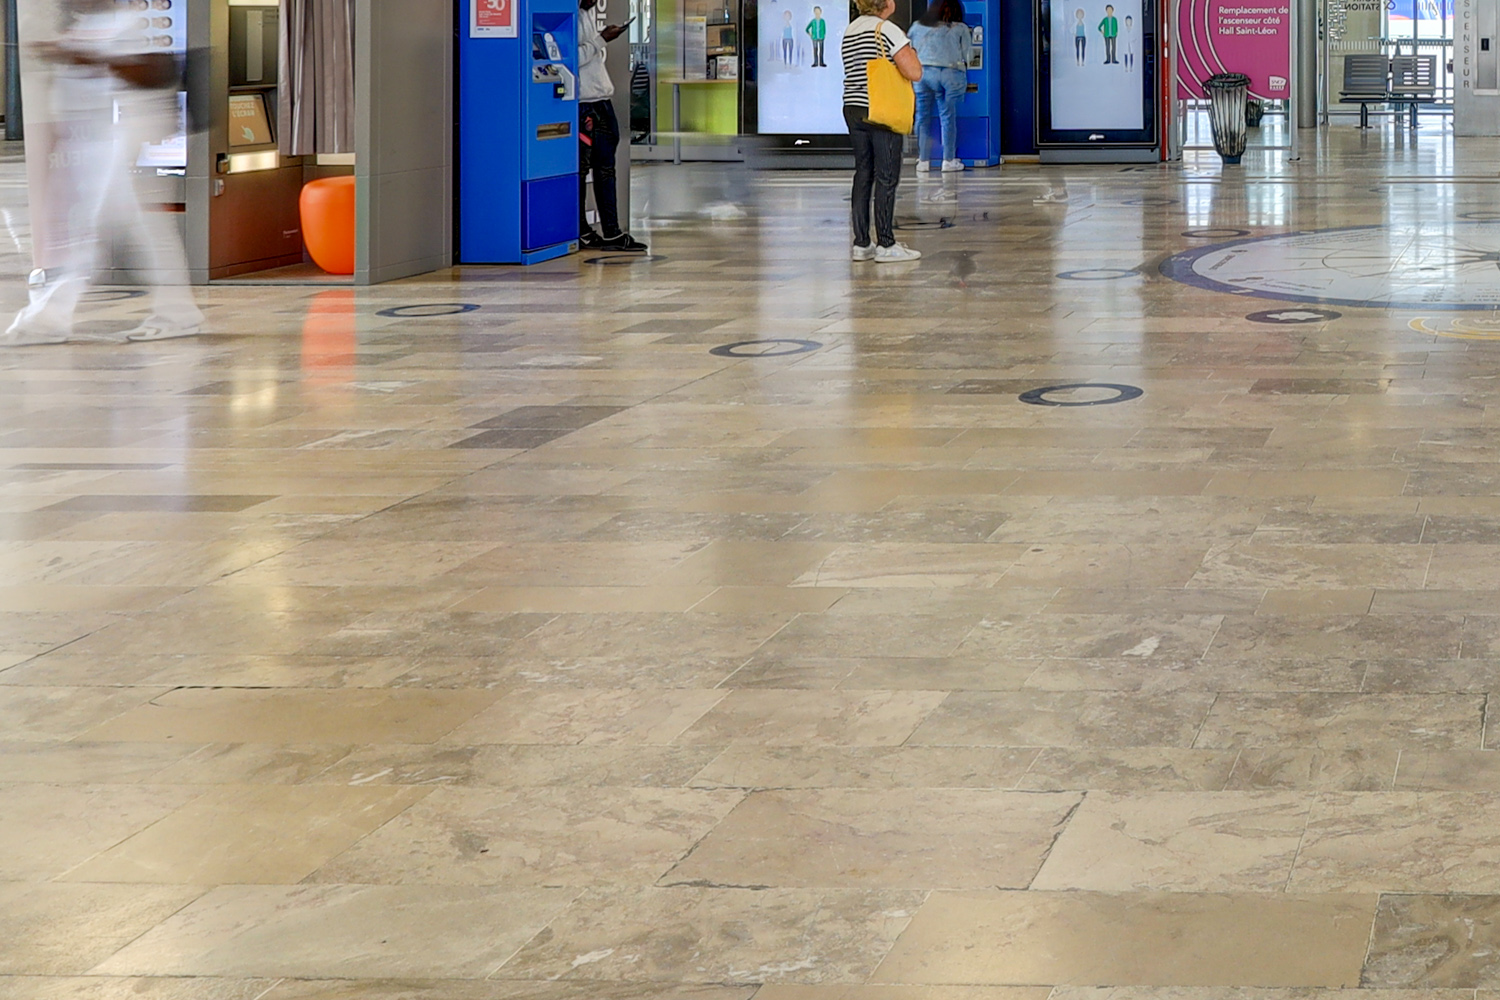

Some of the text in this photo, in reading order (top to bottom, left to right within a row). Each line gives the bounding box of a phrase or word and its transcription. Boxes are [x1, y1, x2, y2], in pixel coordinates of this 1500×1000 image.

[1219, 6, 1276, 16] Remplacement
[1219, 16, 1280, 24] l'ascenseur côté
[1236, 26, 1277, 34] Saint-Léon
